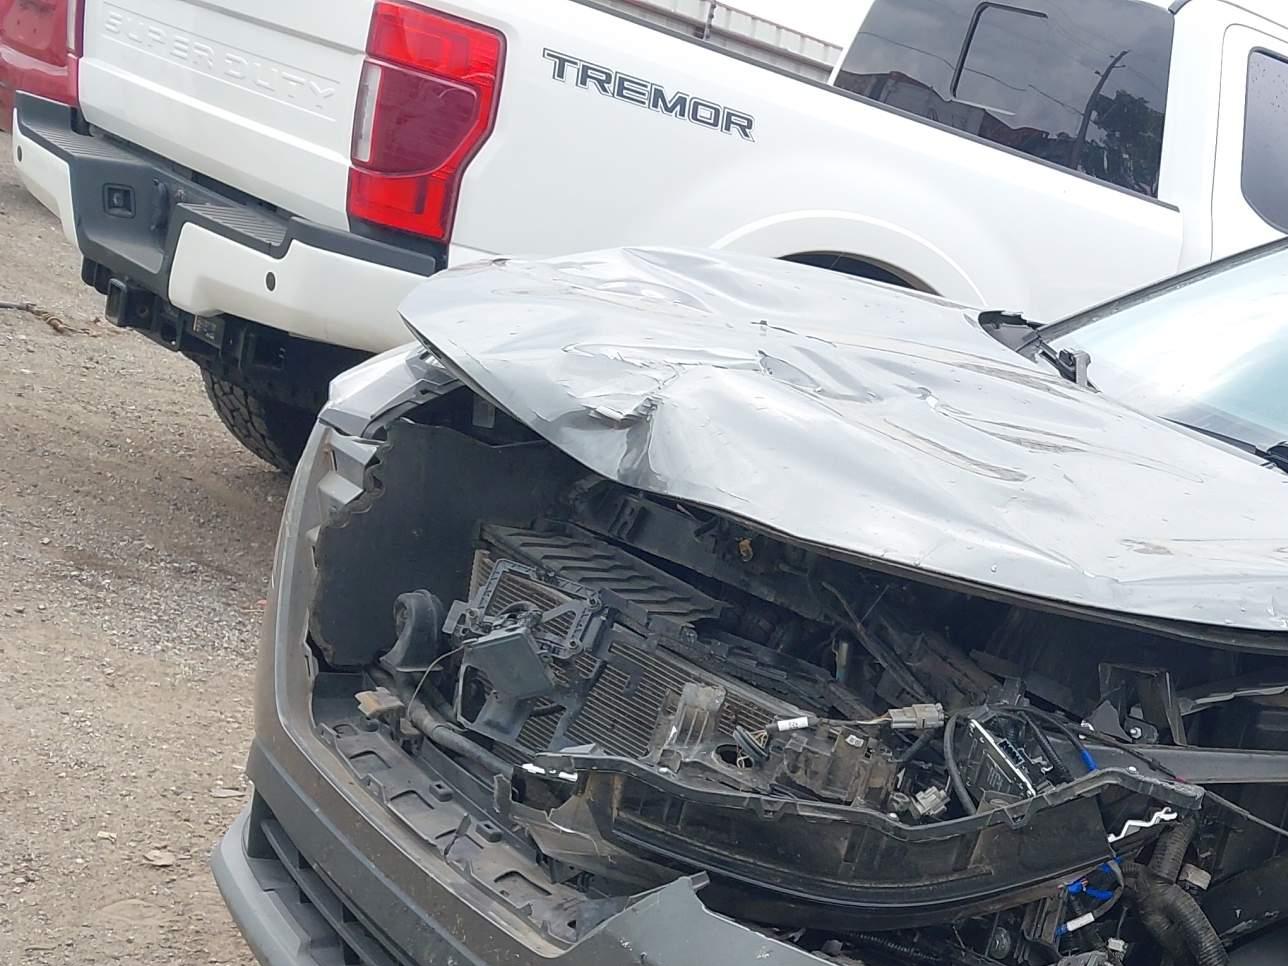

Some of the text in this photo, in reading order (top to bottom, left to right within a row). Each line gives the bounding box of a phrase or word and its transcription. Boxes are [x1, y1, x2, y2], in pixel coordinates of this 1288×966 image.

[104, 10, 337, 110] SUPER DUTY
[542, 47, 756, 143] TREMOR
